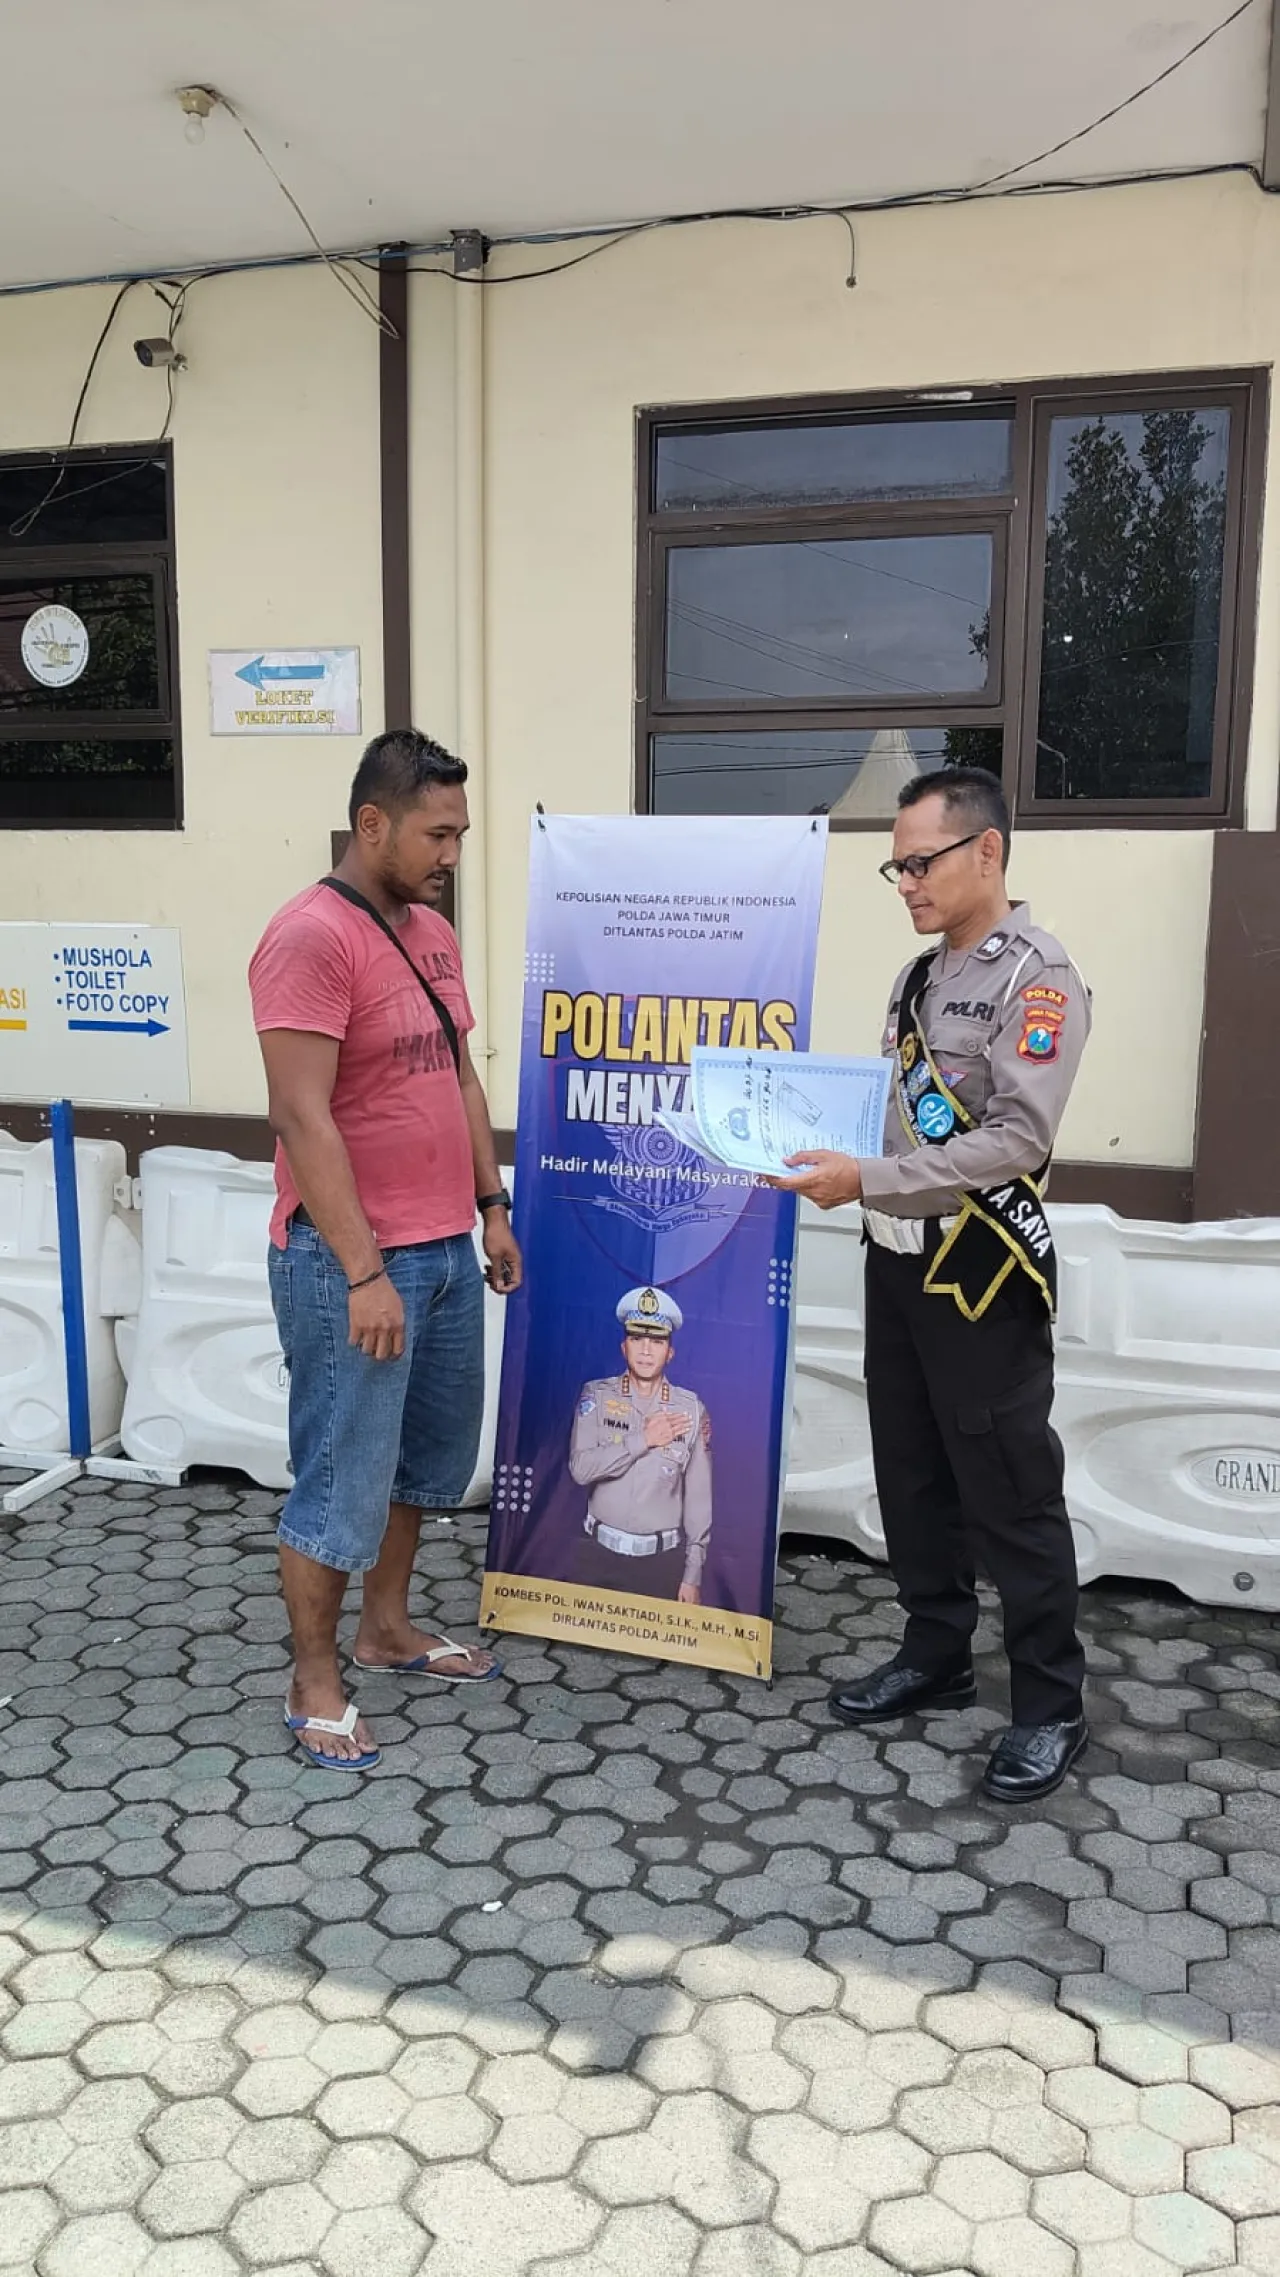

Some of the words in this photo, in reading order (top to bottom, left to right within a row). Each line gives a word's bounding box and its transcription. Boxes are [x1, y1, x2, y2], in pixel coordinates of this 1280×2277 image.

[255, 690, 313, 706] LOKET
[235, 710, 336, 725] VERIFIKASI
[556, 891, 621, 904] KEPOLISIAN
[624, 893, 670, 905] NEGARA
[673, 895, 730, 907] REPUBLIK
[731, 896, 797, 908] INDONESIA
[617, 910, 656, 921] POLDA
[658, 911, 690, 922] JAWA
[693, 912, 730, 923] TIMUR
[603, 926, 665, 938] DITLANTAS
[667, 928, 706, 939] POLDA
[709, 929, 743, 941] JATIM
[63, 947, 152, 969] MUSHOLA
[65, 970, 126, 990] TOILET
[66, 993, 114, 1012] FOTO
[120, 994, 169, 1014] COPY
[1026, 989, 1063, 1003] POLDA
[941, 1000, 995, 1021] POLRI
[541, 989, 796, 1066] POLANTAS
[540, 1155, 588, 1173] Hadir
[592, 1159, 670, 1183] Melayani
[1008, 1201, 1052, 1258] SAYA
[603, 1417, 629, 1431] IWAN
[494, 1585, 541, 1602] KOMBES
[544, 1593, 570, 1607] POL.
[573, 1598, 604, 1613] IWAN
[606, 1603, 663, 1626] SAKTIADI,
[552, 1612, 616, 1634] DIRLANTAS
[619, 1624, 659, 1641] POLDA
[661, 1631, 697, 1649] JATIM
